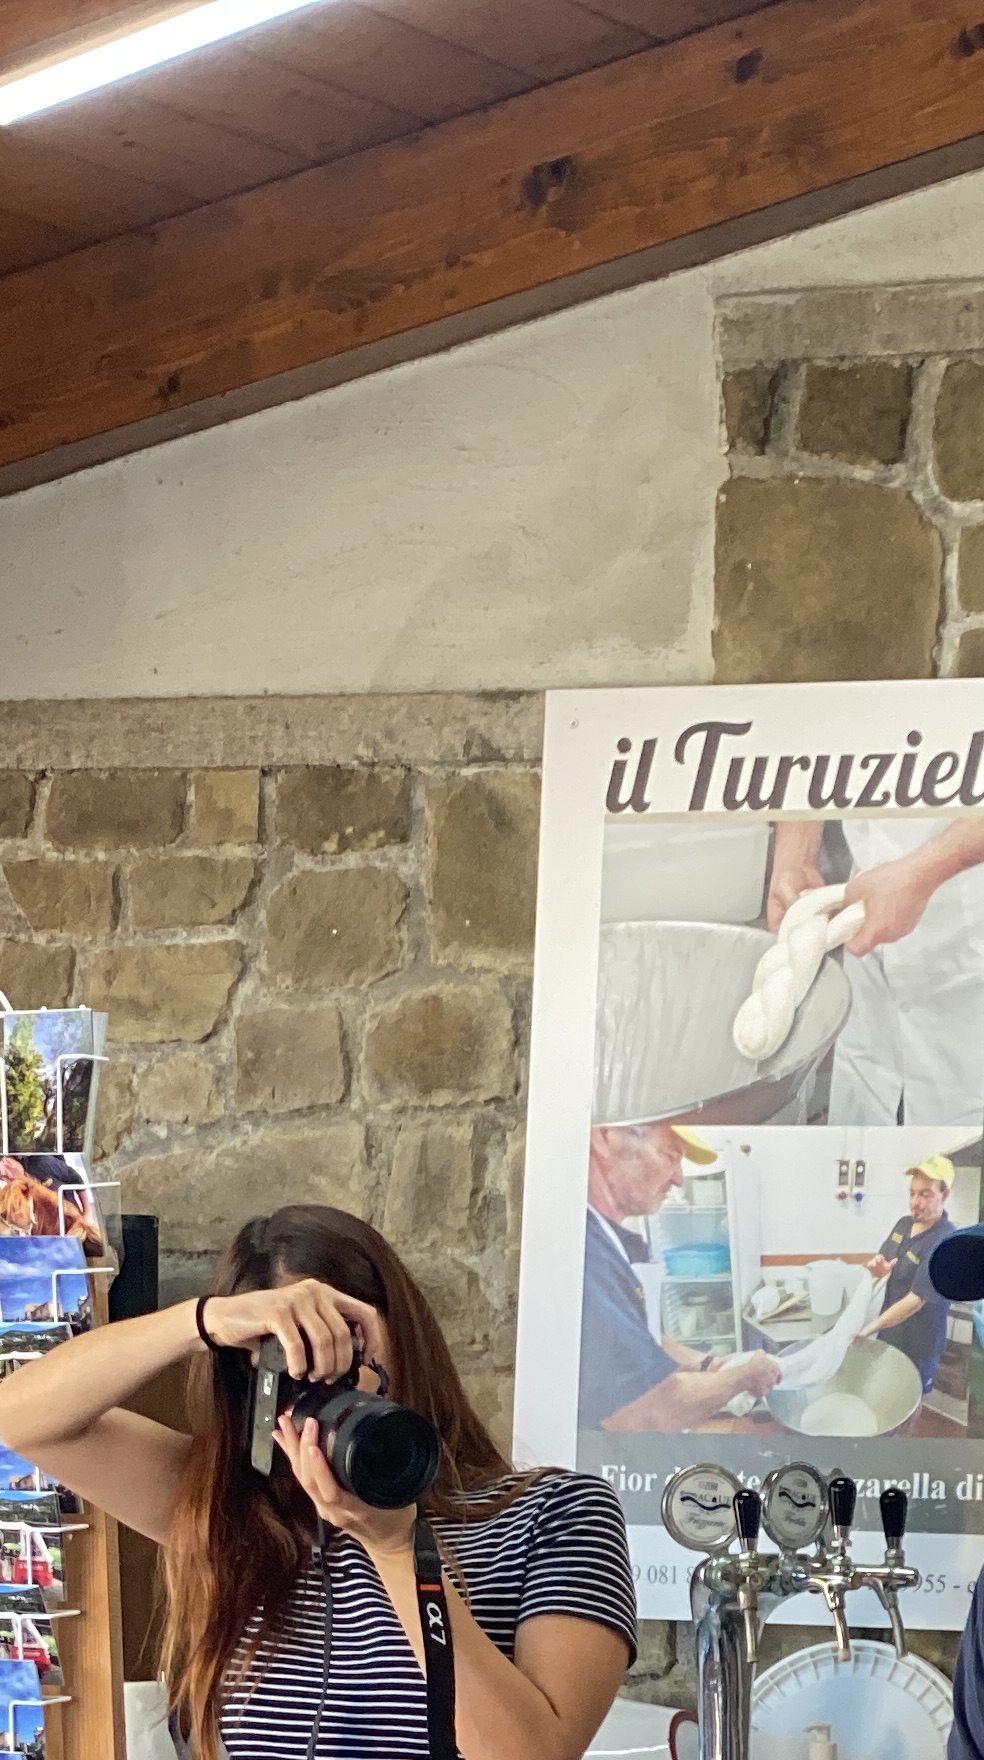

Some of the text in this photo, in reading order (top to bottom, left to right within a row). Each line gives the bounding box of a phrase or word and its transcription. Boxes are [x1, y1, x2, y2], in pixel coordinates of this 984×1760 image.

[605, 737, 658, 814] il
[601, 1465, 657, 1492] Fior
[956, 1473, 984, 1501] di
[647, 1565, 677, 1585] 081
